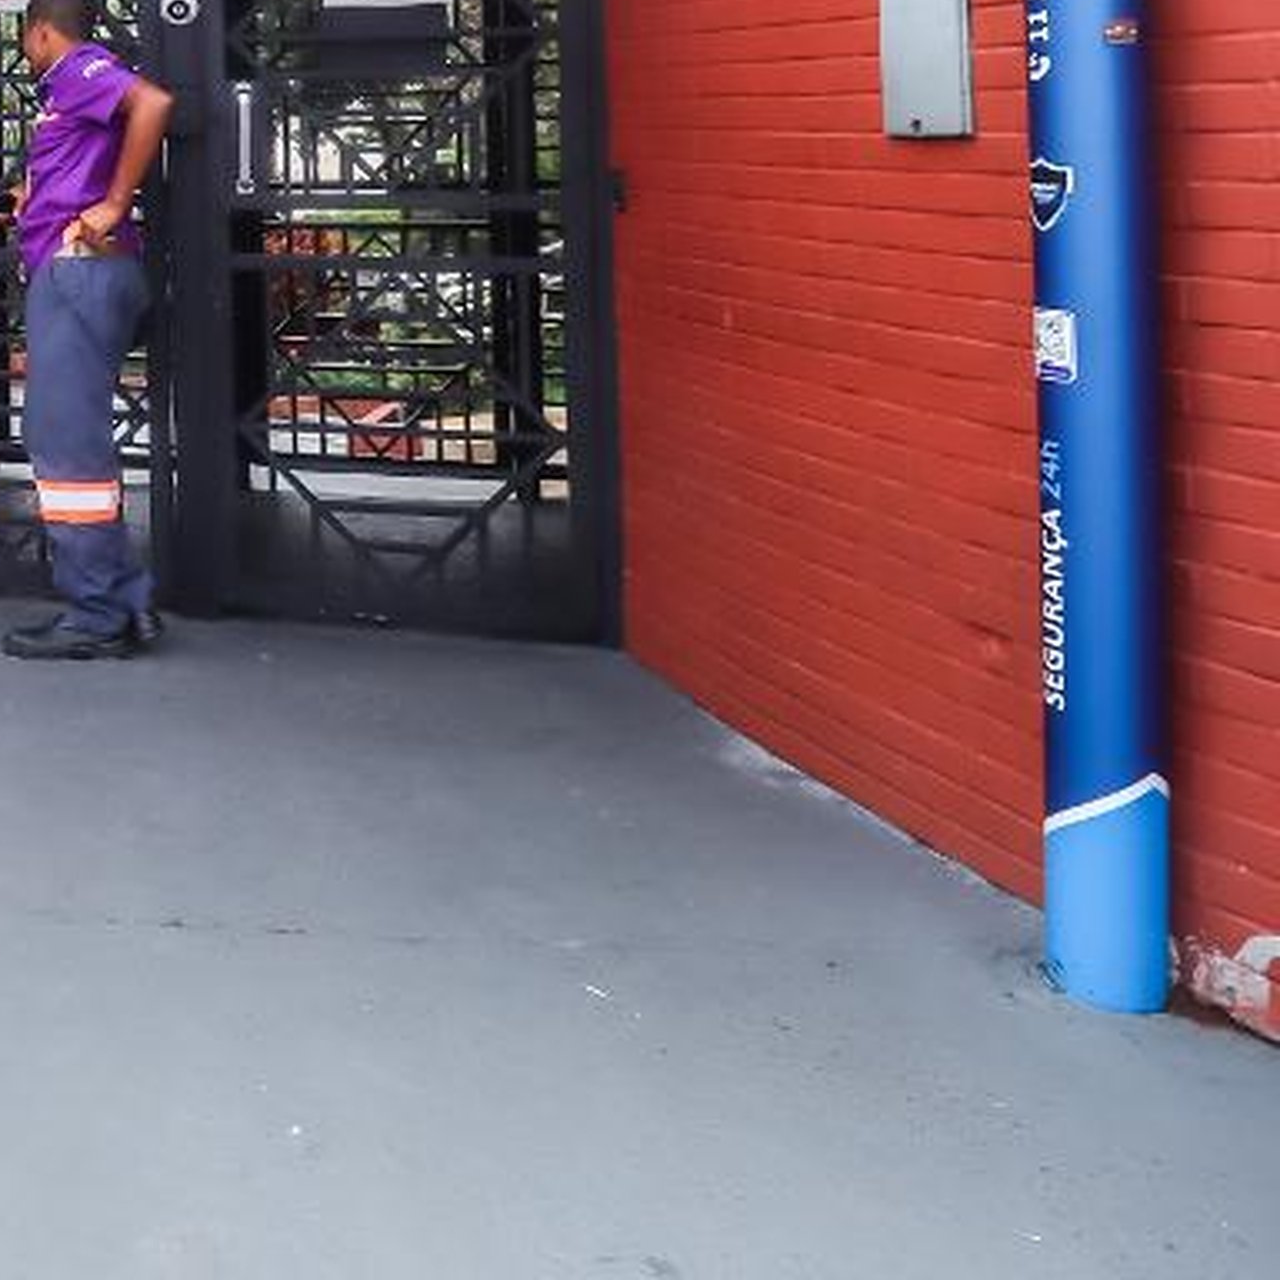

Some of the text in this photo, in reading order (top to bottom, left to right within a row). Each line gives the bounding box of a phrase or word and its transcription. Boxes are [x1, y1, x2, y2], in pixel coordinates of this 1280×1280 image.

[1028, 9, 1049, 41] 11
[1041, 440, 1069, 711] SEGURANÇA 24h
